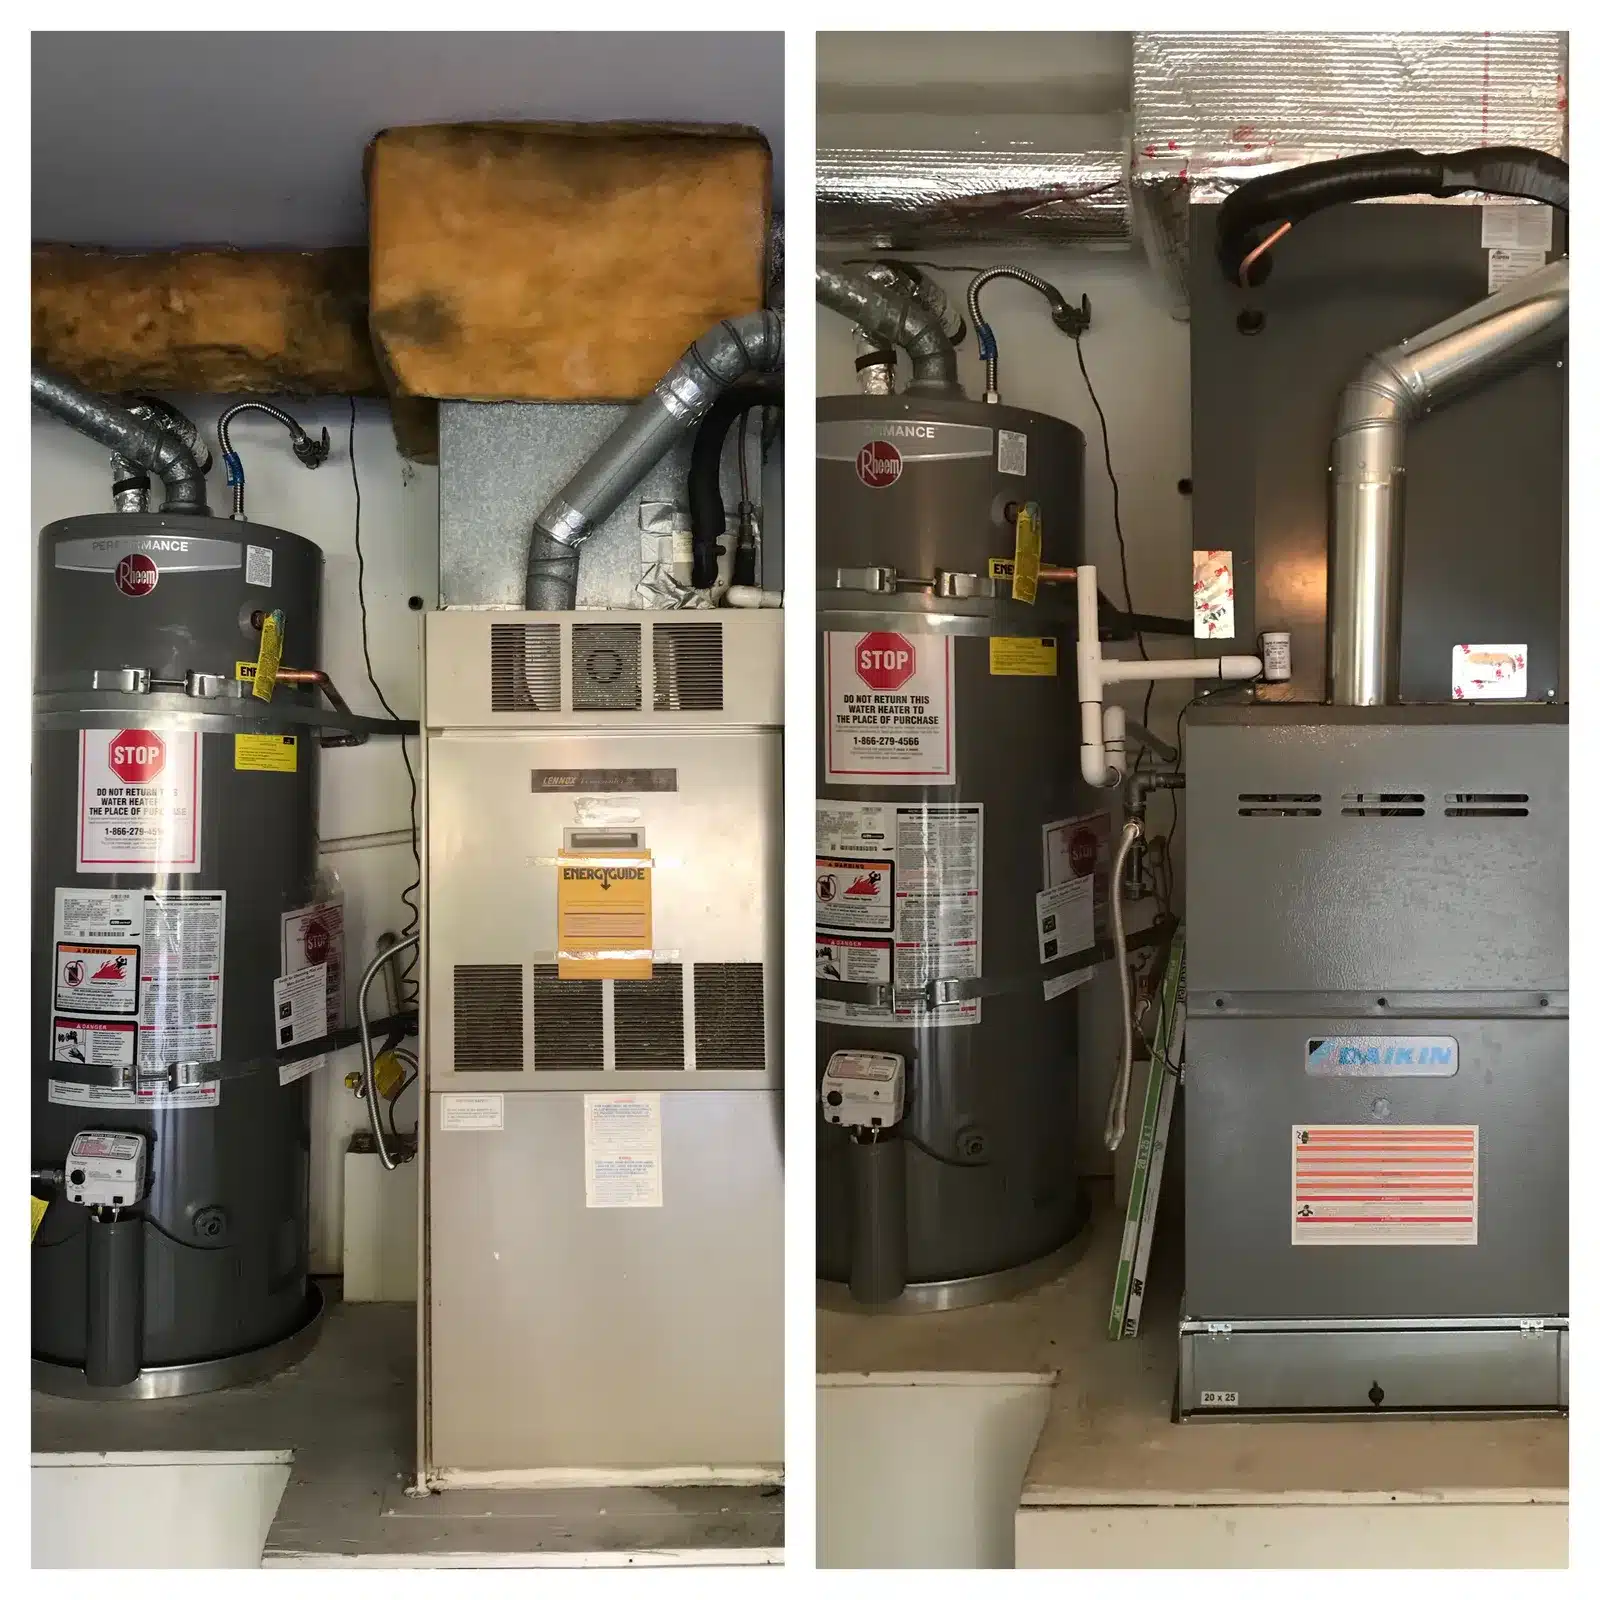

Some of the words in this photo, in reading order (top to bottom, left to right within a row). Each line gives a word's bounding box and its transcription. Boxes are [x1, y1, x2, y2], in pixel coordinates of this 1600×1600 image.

[861, 441, 900, 480] Rheem
[119, 554, 157, 590] Rheem
[861, 650, 909, 670] STOP
[844, 695, 855, 704] DO
[856, 695, 872, 704] NOT
[874, 695, 908, 704] RETURN
[910, 695, 930, 704] THIS
[848, 705, 876, 714] WATER
[877, 705, 910, 714] HEATER
[913, 705, 924, 714] TO
[836, 715, 851, 724] THE
[852, 715, 878, 724] PLACE
[880, 715, 891, 724] OF
[893, 715, 939, 725] PURCHASE
[853, 737, 920, 746] 1-866-279-4566
[114, 746, 160, 765] STOP
[543, 776, 577, 785] LENNOX
[97, 788, 107, 797] DO
[108, 788, 124, 797] NOT
[126, 788, 157, 797] RETURN
[101, 797, 127, 806] WATER
[89, 807, 103, 816] THE
[104, 807, 128, 816] PLACE
[130, 807, 141, 816] OF
[563, 867, 645, 881] ENERGYGUIDE
[307, 933, 328, 950] STOP
[1339, 1047, 1451, 1065] DAIKIN
[1140, 1140, 1150, 1150] 25
[1137, 1158, 1147, 1170] 20
[1204, 1393, 1215, 1402] 20
[1225, 1393, 1236, 1402] 25
